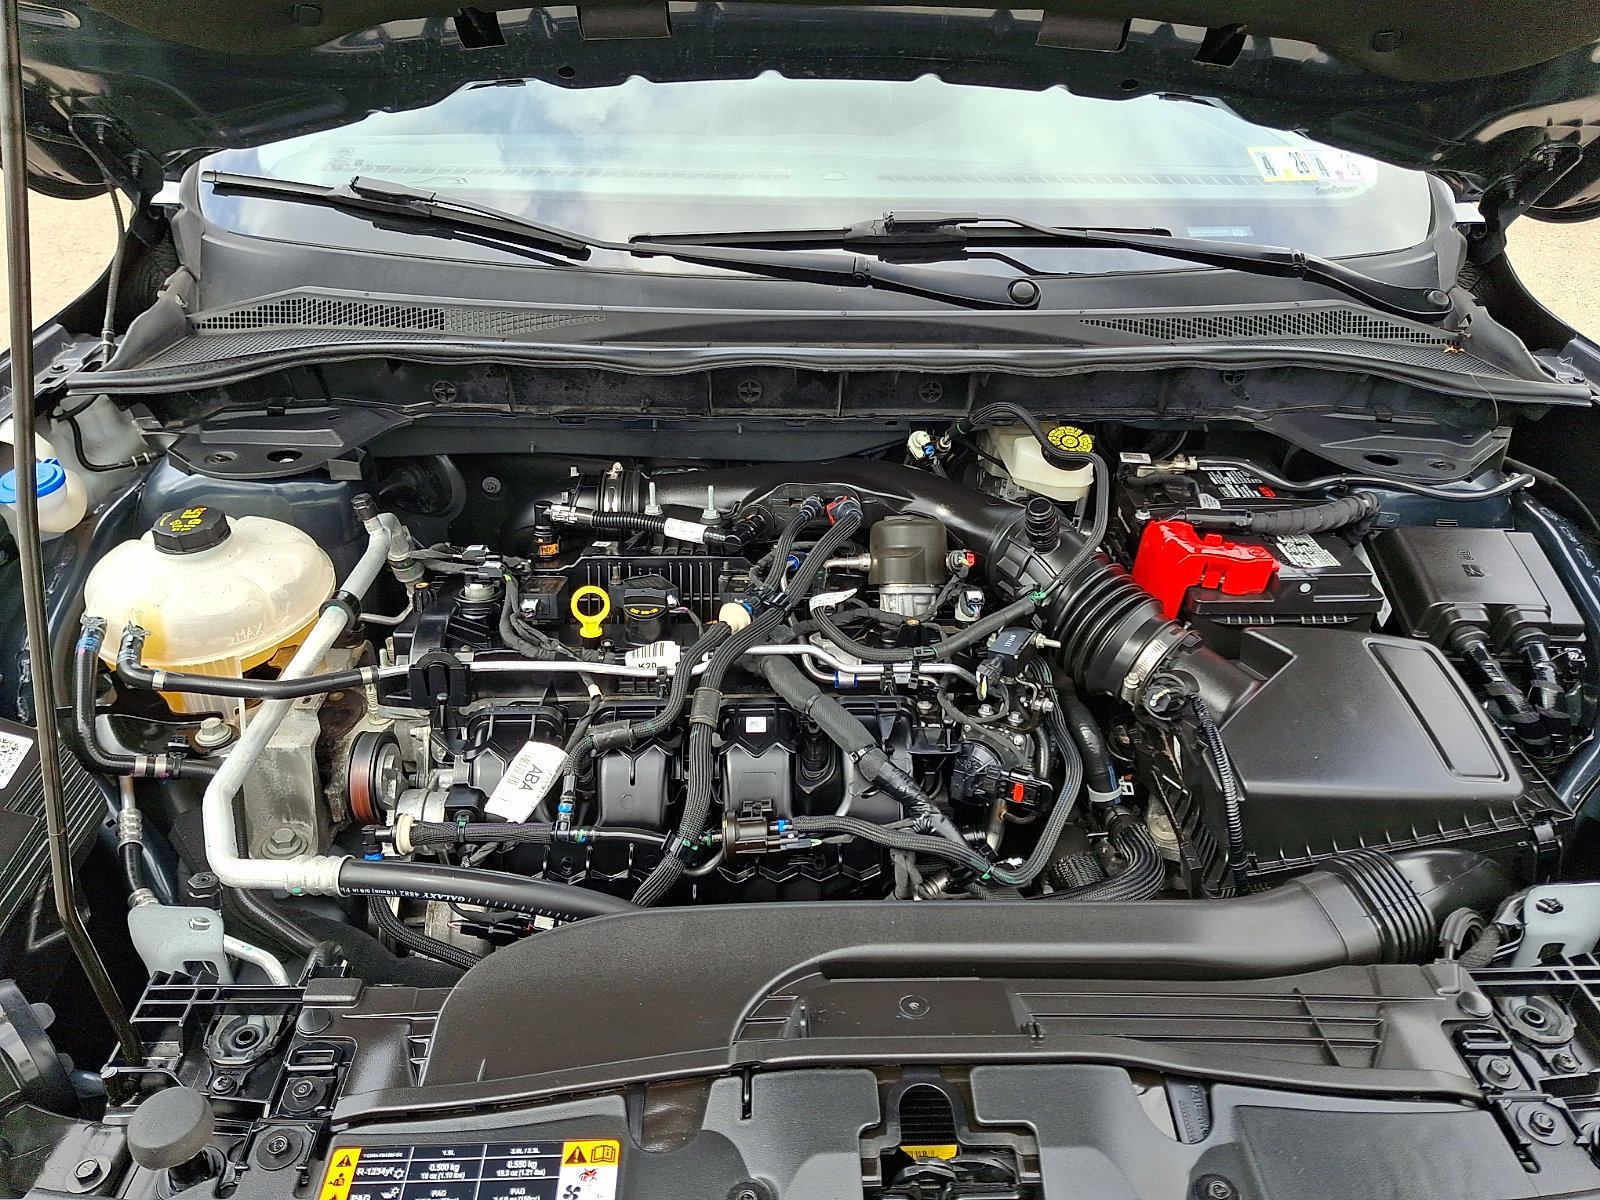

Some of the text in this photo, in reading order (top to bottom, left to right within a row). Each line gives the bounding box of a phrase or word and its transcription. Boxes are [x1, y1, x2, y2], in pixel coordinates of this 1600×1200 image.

[1288, 151, 1311, 174] 26
[518, 763, 544, 791] ABA
[399, 890, 420, 898] 4882
[422, 892, 466, 903] GALAXY
[450, 1163, 461, 1173] kg
[527, 1159, 538, 1170] kg
[430, 1189, 448, 1198] PAG
[509, 1187, 526, 1196] PAG
